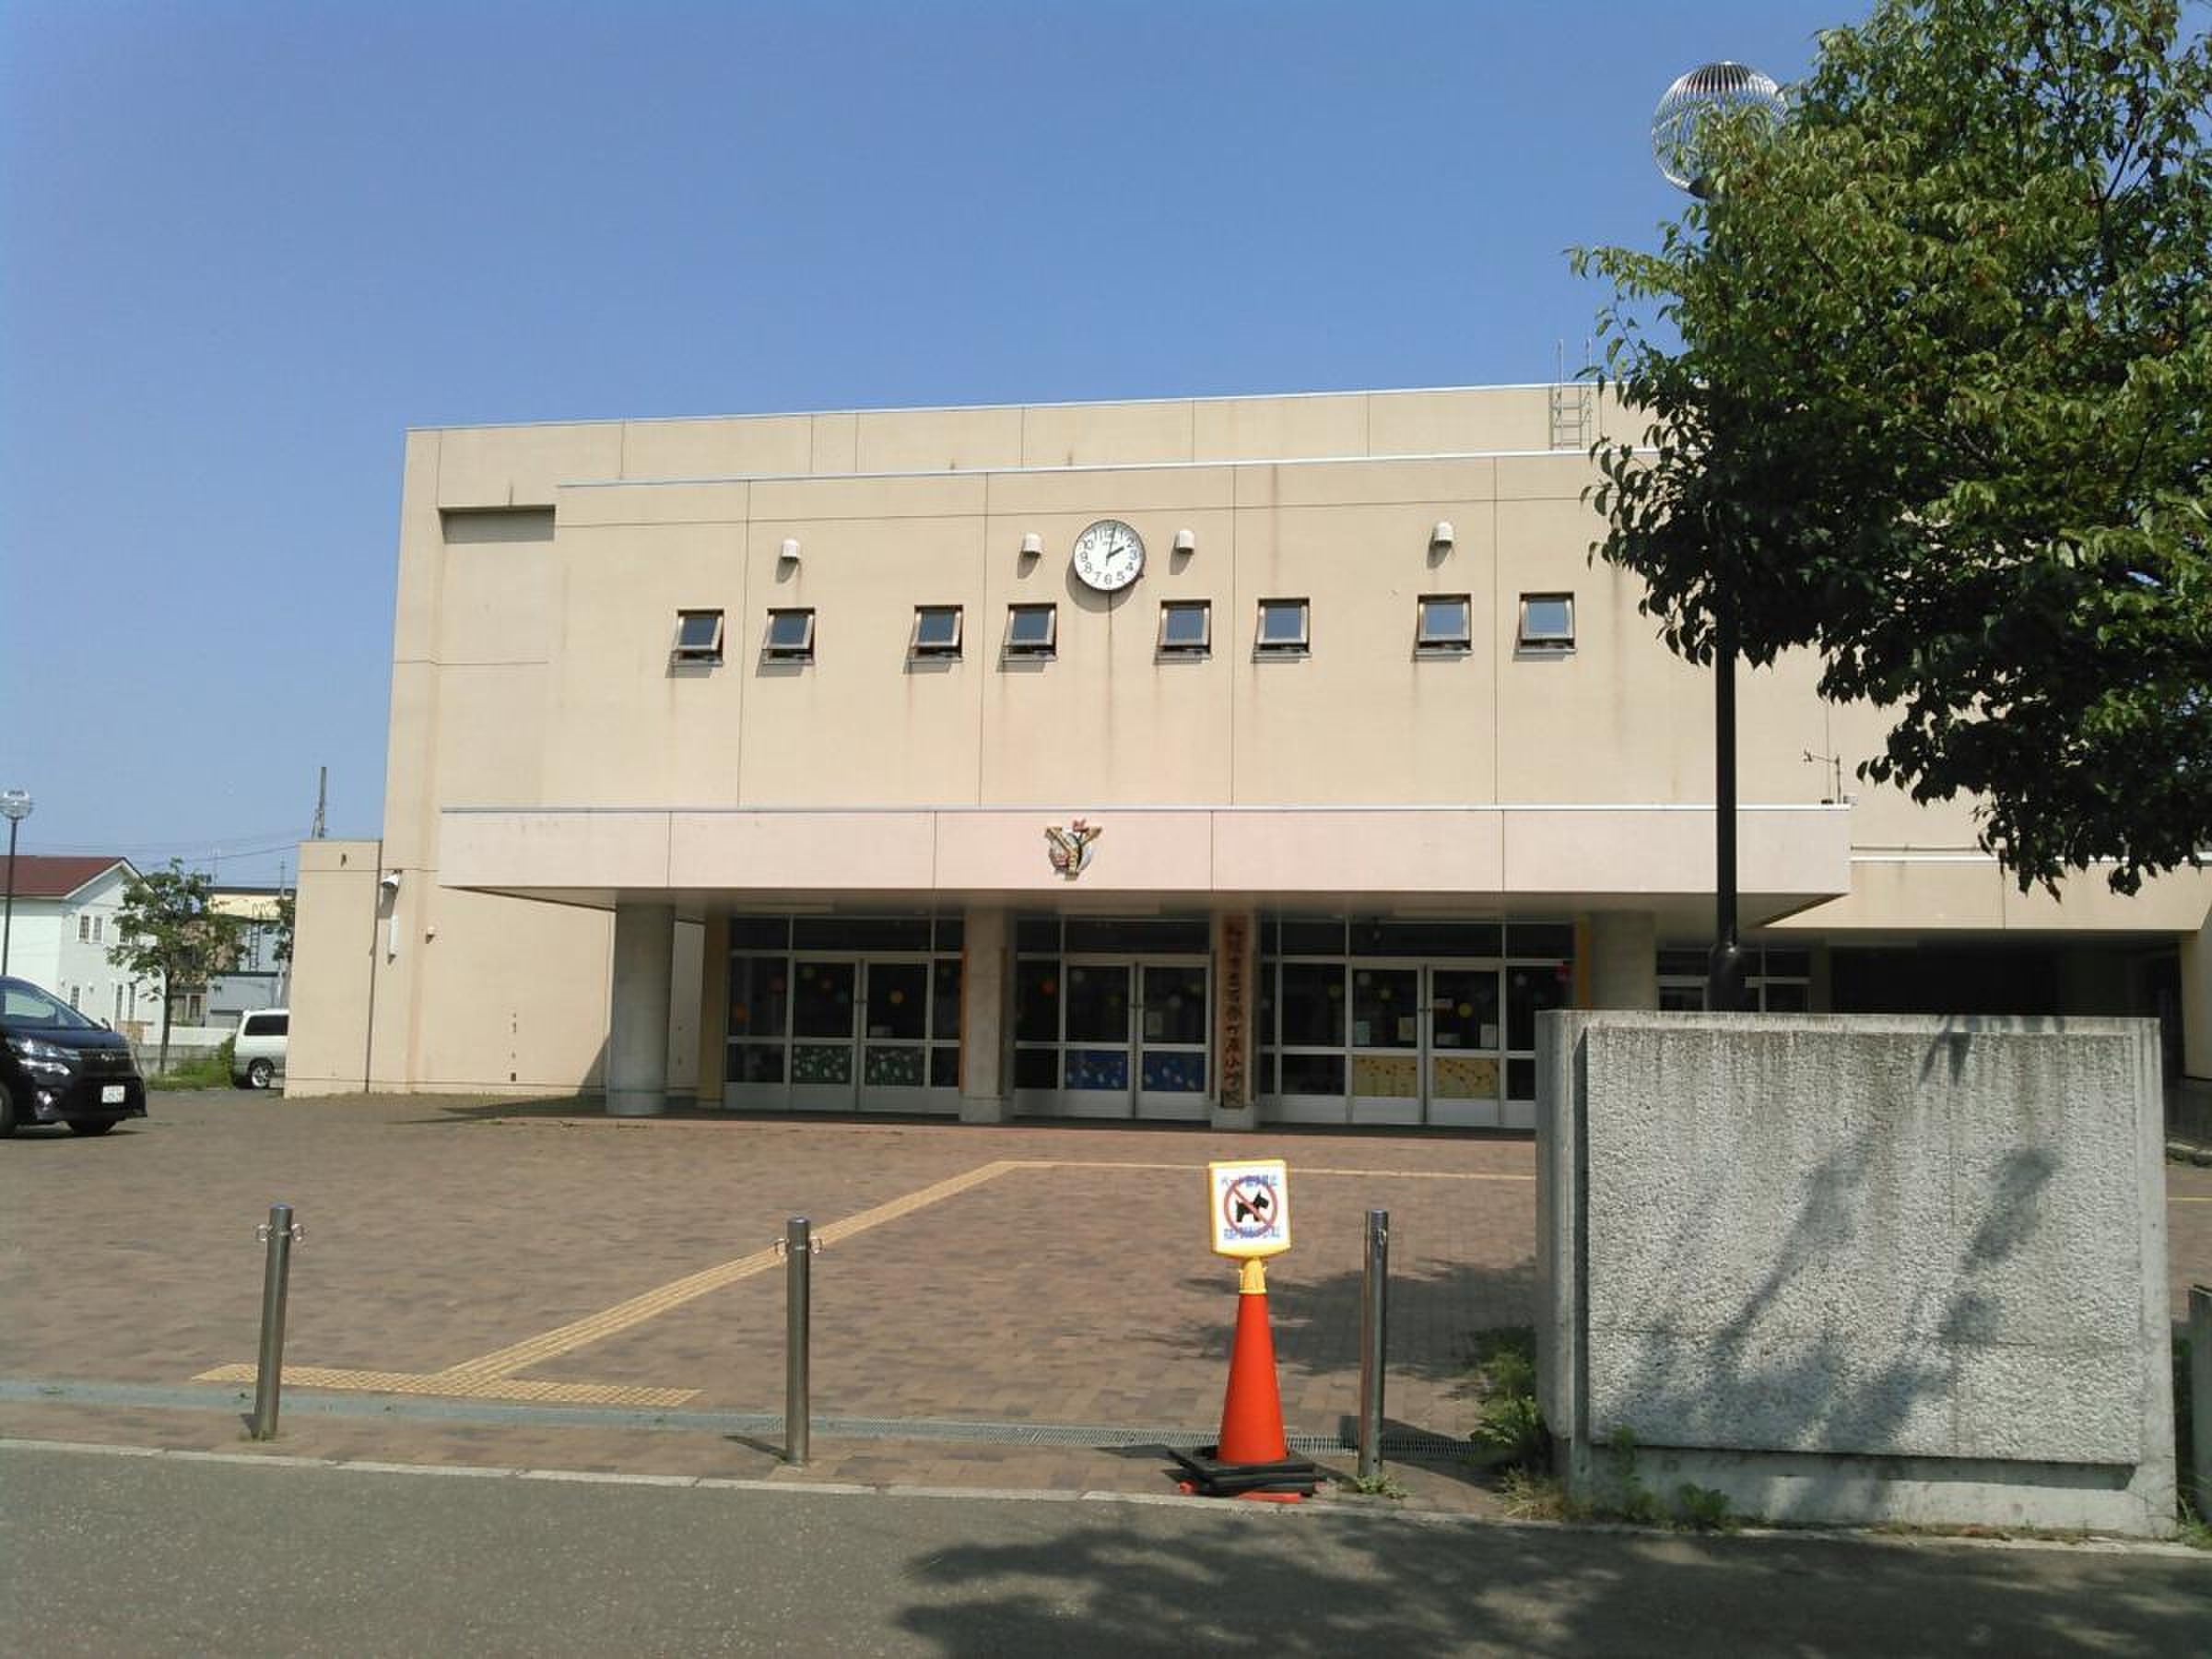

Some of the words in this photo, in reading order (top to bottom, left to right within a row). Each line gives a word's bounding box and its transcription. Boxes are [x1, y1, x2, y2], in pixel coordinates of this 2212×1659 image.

[1126, 536, 1135, 547] 2
[1079, 551, 1088, 562] 9
[1129, 548, 1137, 560] 3
[1084, 561, 1092, 573] 8
[1094, 571, 1102, 582] 7
[1104, 572, 1112, 585] 6
[1116, 571, 1125, 582] 5
